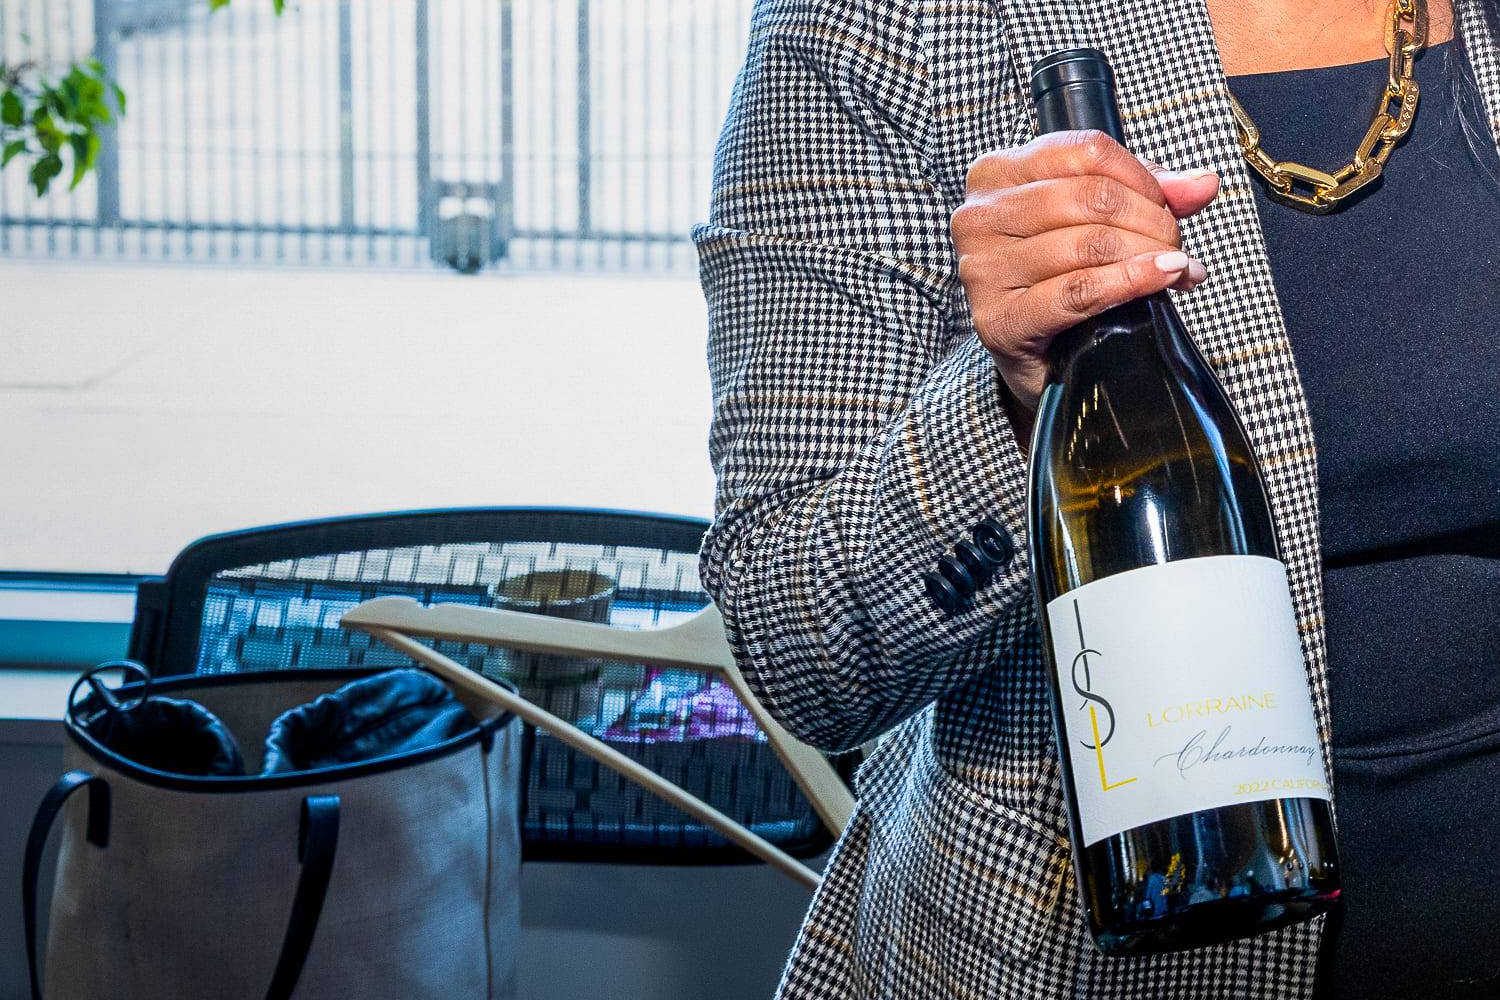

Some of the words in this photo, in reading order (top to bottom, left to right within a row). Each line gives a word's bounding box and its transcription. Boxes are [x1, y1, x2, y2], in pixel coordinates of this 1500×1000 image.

[1147, 692, 1279, 728] LORRAINE
[1153, 725, 1317, 780] Chardonnay
[1233, 780, 1270, 796] 2022
